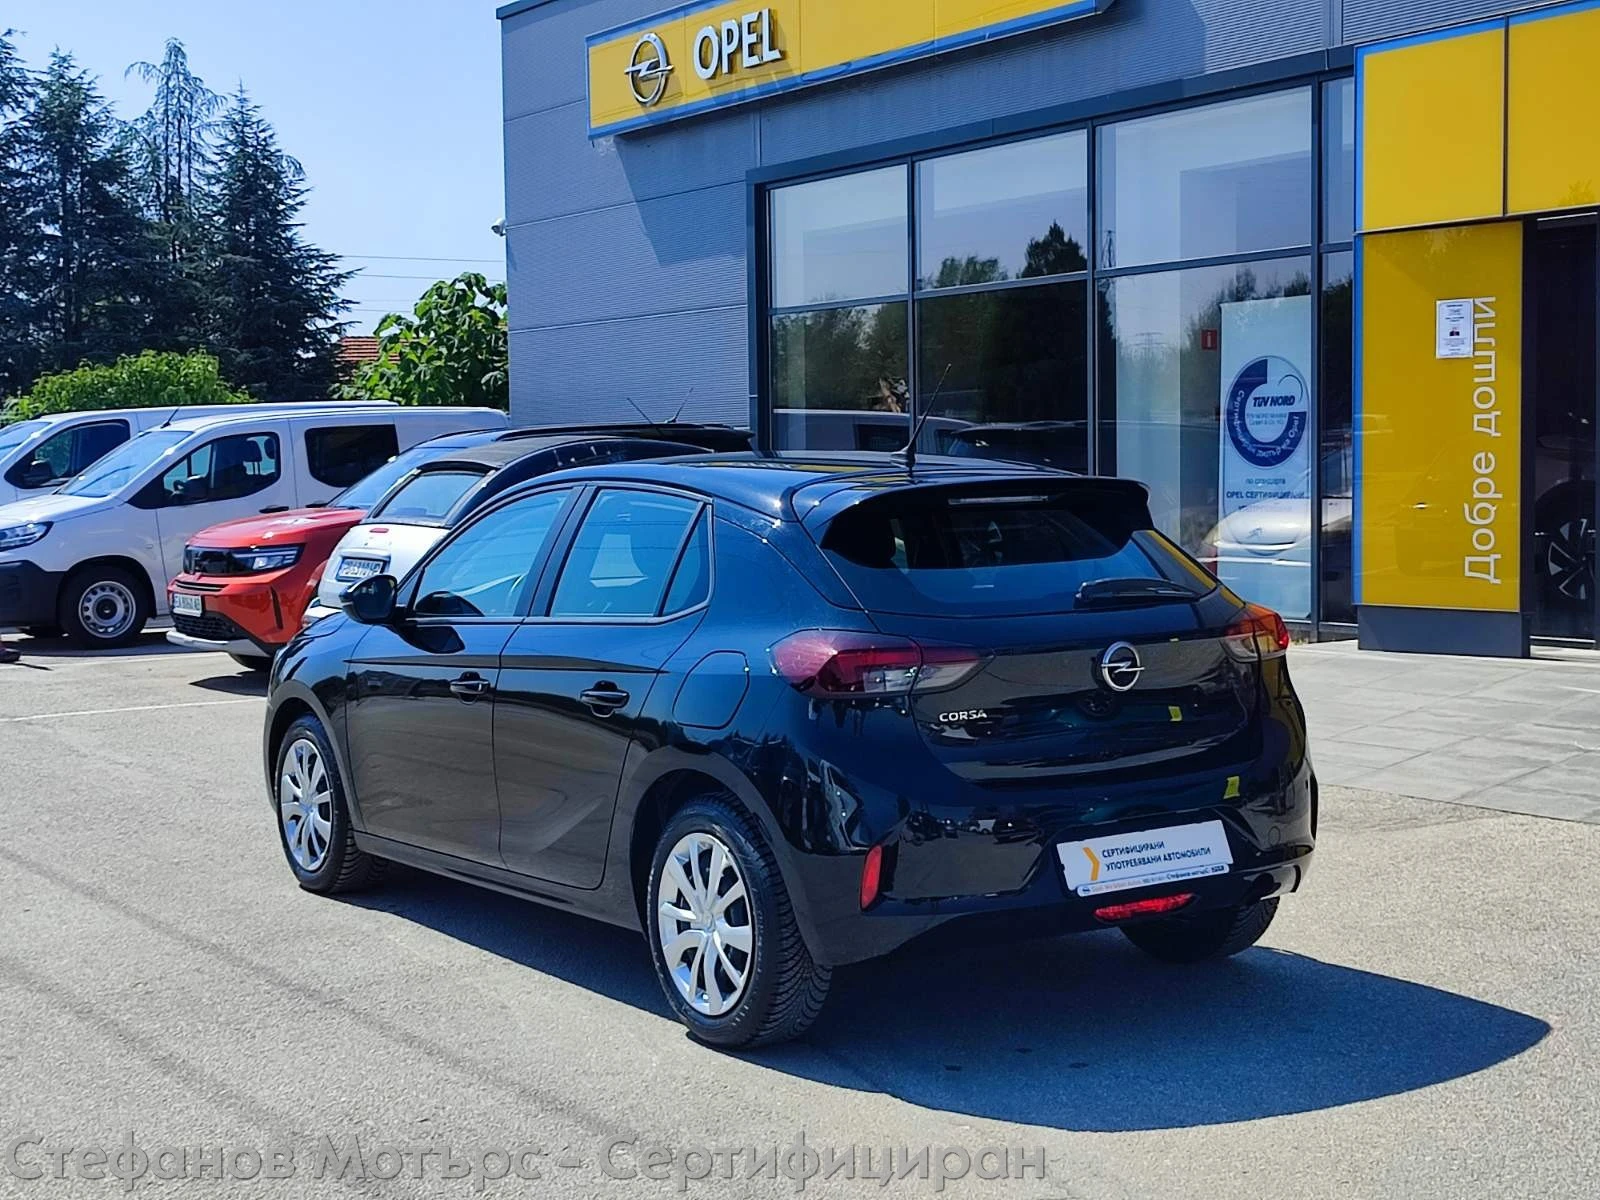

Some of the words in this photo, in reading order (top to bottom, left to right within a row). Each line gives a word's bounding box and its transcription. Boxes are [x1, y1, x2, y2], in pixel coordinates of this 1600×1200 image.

[694, 8, 782, 79] OPEL
[1473, 296, 1501, 437] дошли
[1270, 394, 1296, 407] NORD
[1225, 490, 1244, 499] OPEL
[1463, 451, 1502, 584] Добре
[939, 709, 988, 722] CORSA
[1101, 840, 1165, 859] СЕРТИФИЦИРАНИ
[1105, 855, 1162, 872] УПОТРЕБЯВАНИ
[1162, 846, 1212, 863] АВТОМОБИЛИ
